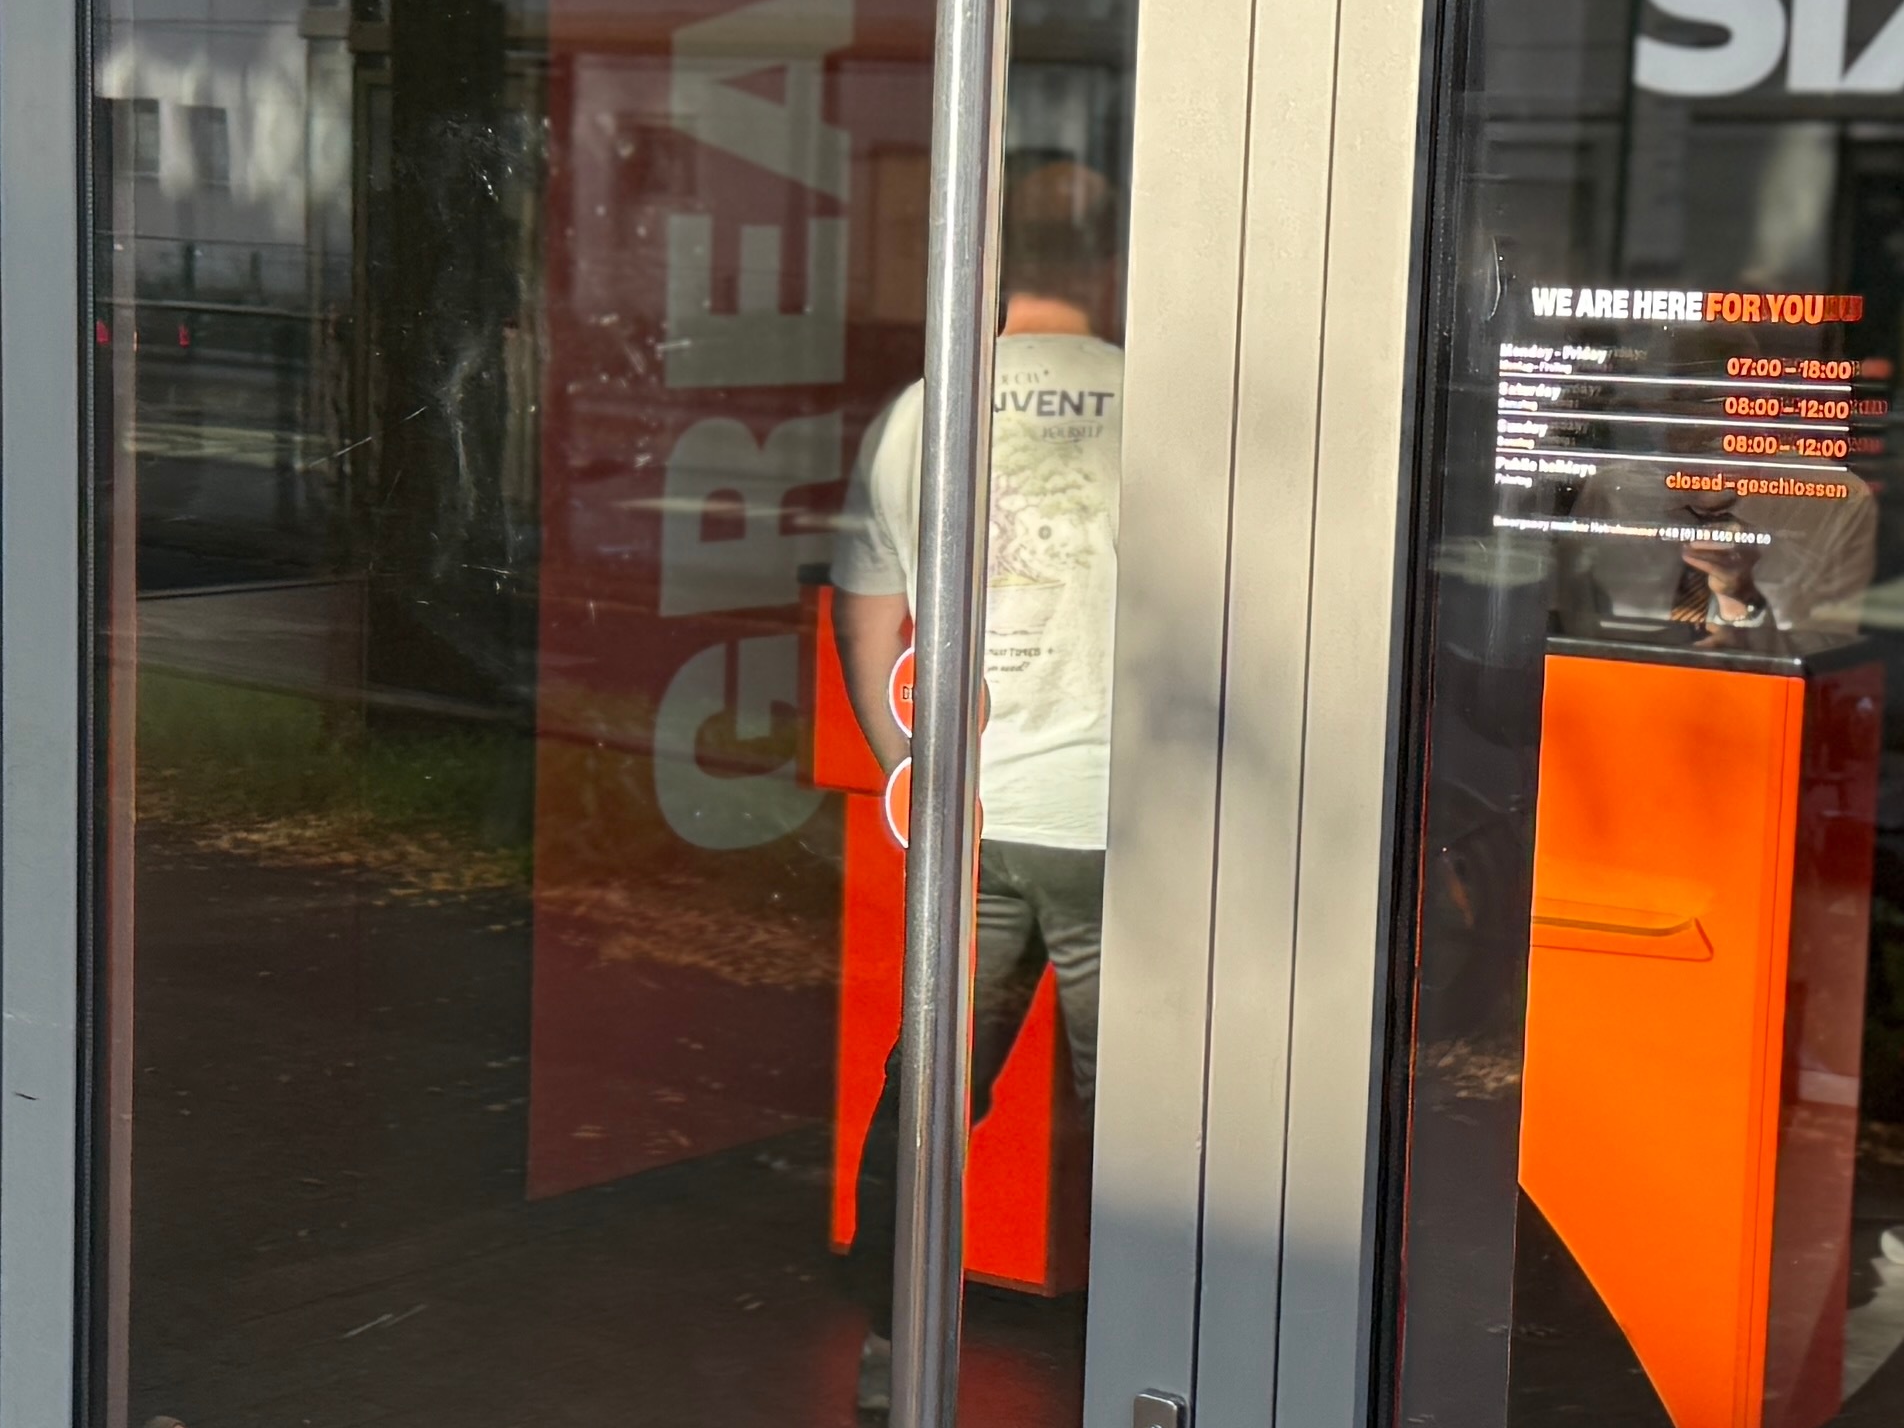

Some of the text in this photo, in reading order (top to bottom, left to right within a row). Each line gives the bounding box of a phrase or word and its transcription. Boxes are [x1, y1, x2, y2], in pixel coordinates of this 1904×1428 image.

[1531, 286, 1824, 324] WE ARE HERE FOR YOU
[1726, 357, 1782, 377] 07:00
[1798, 360, 1852, 380] 18:00
[1724, 397, 1780, 417] 08:00
[1798, 399, 1850, 419] 12:00
[1723, 434, 1777, 454] 08:00
[1796, 438, 1847, 458] 12:00
[1665, 471, 1722, 491] closed
[1736, 477, 1847, 498] geschlossen
